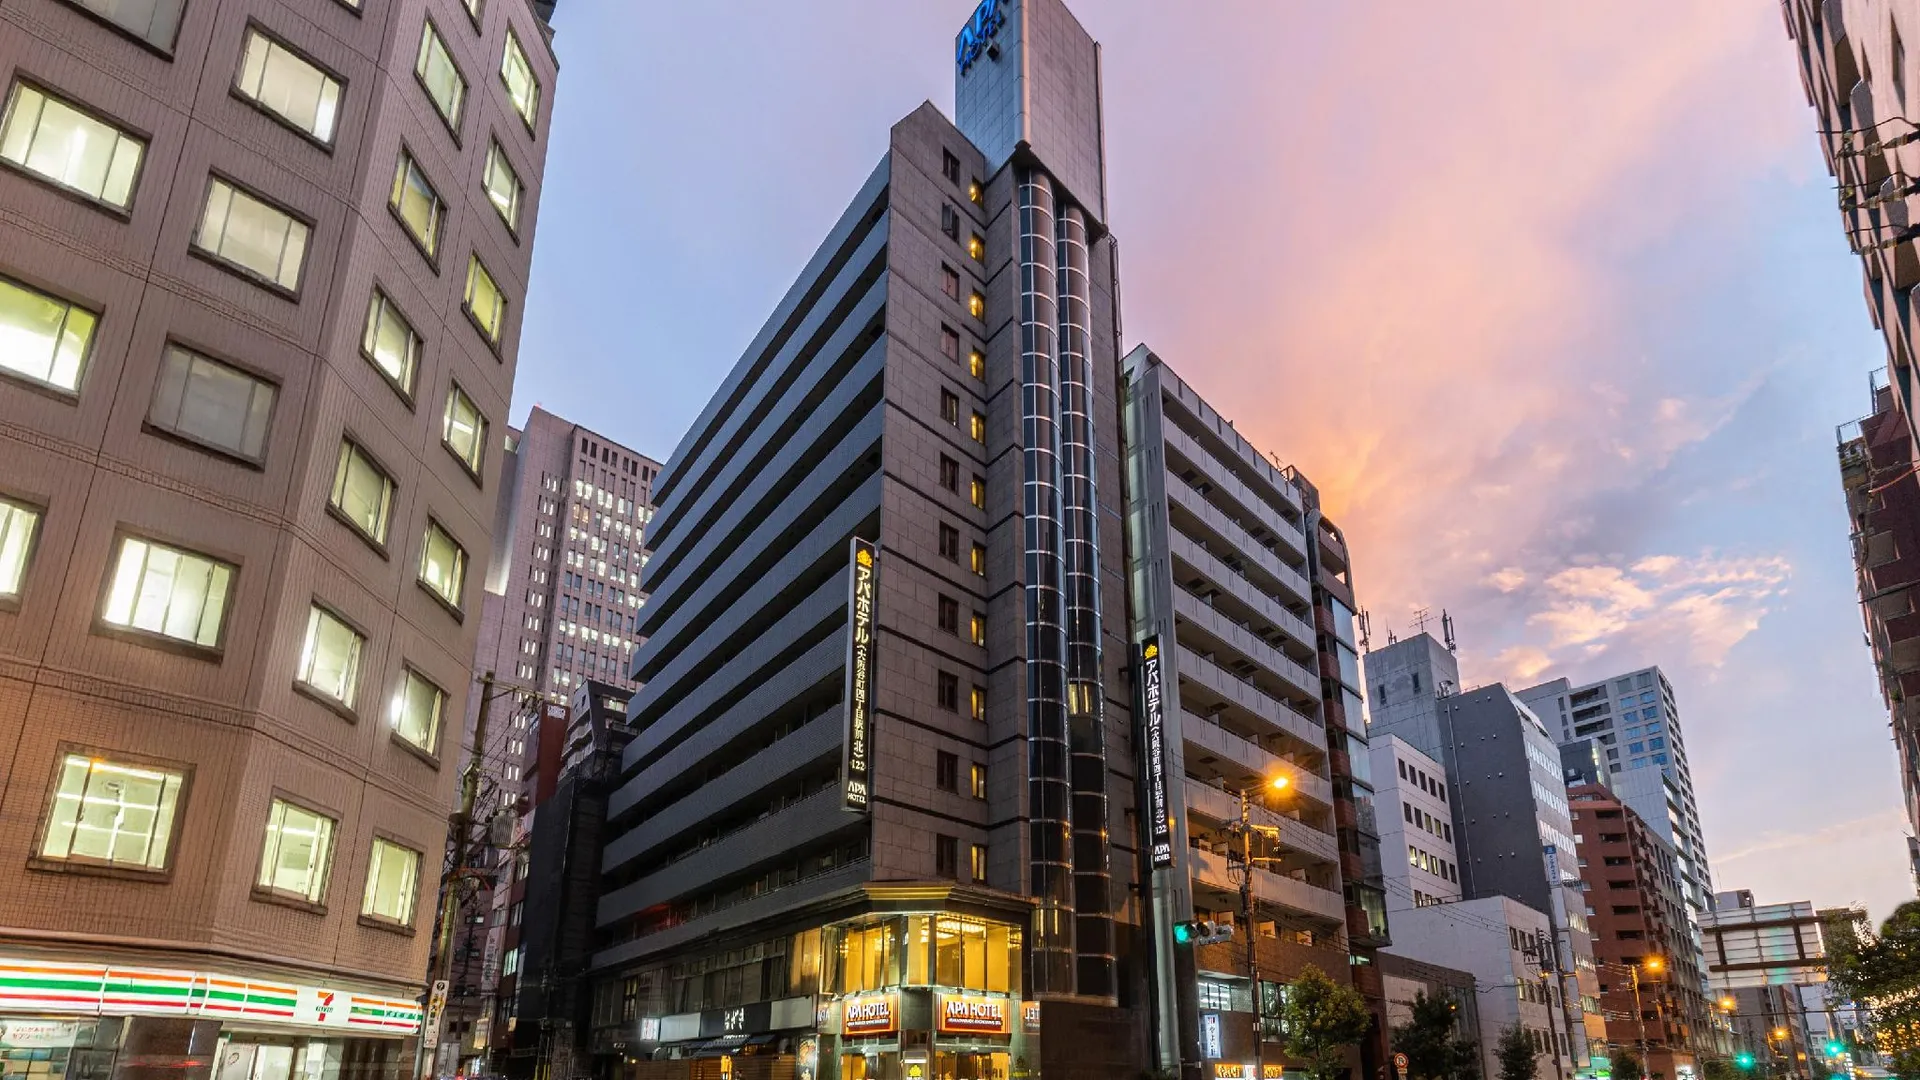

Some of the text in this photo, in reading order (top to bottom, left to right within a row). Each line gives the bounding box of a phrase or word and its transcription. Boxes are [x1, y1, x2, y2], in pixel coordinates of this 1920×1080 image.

[848, 781, 866, 796] APA
[848, 1002, 889, 1019] APA HOTEL
[947, 1001, 1003, 1018] APA HOTEL
